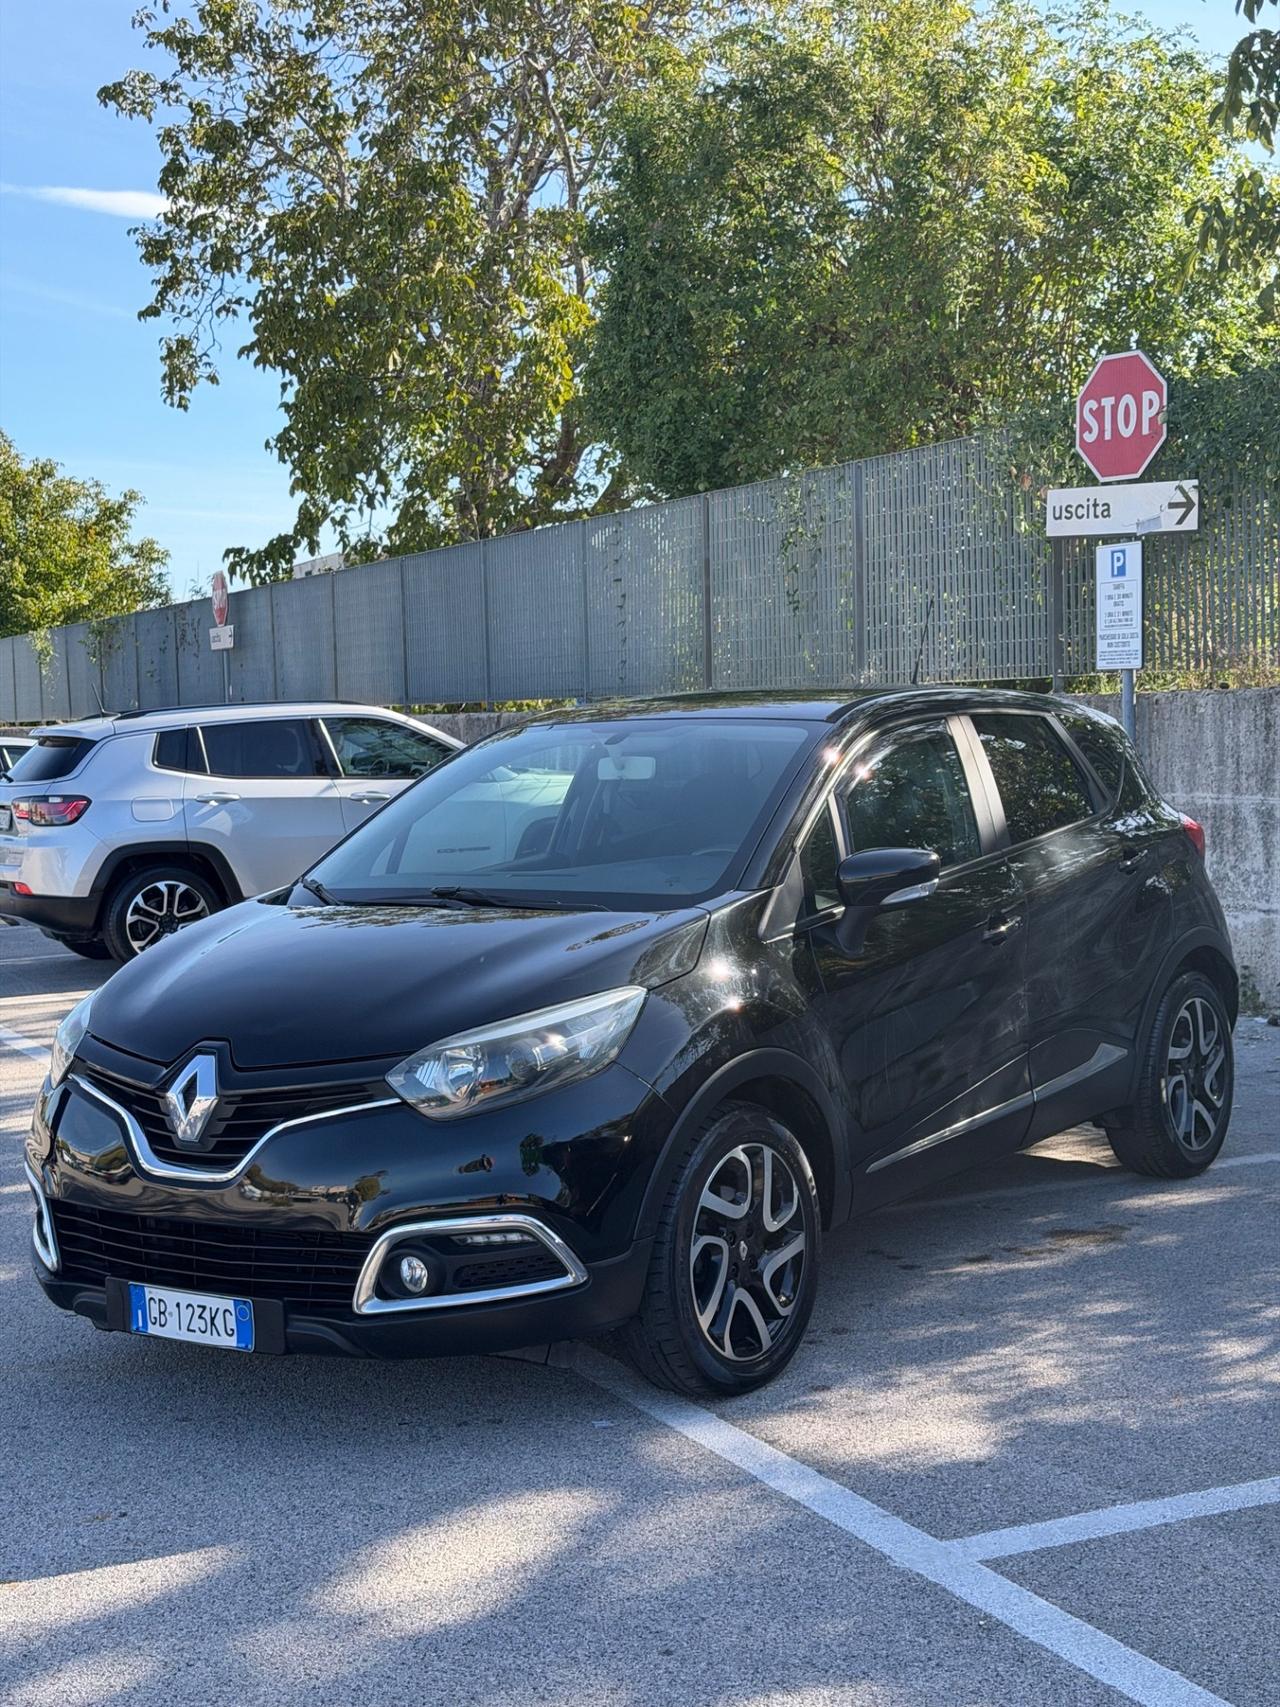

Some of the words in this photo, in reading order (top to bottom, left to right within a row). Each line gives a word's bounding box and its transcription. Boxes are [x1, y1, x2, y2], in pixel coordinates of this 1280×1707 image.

[1083, 390, 1160, 443] STOP
[1053, 498, 1111, 520] uscita
[1113, 552, 1124, 576] P
